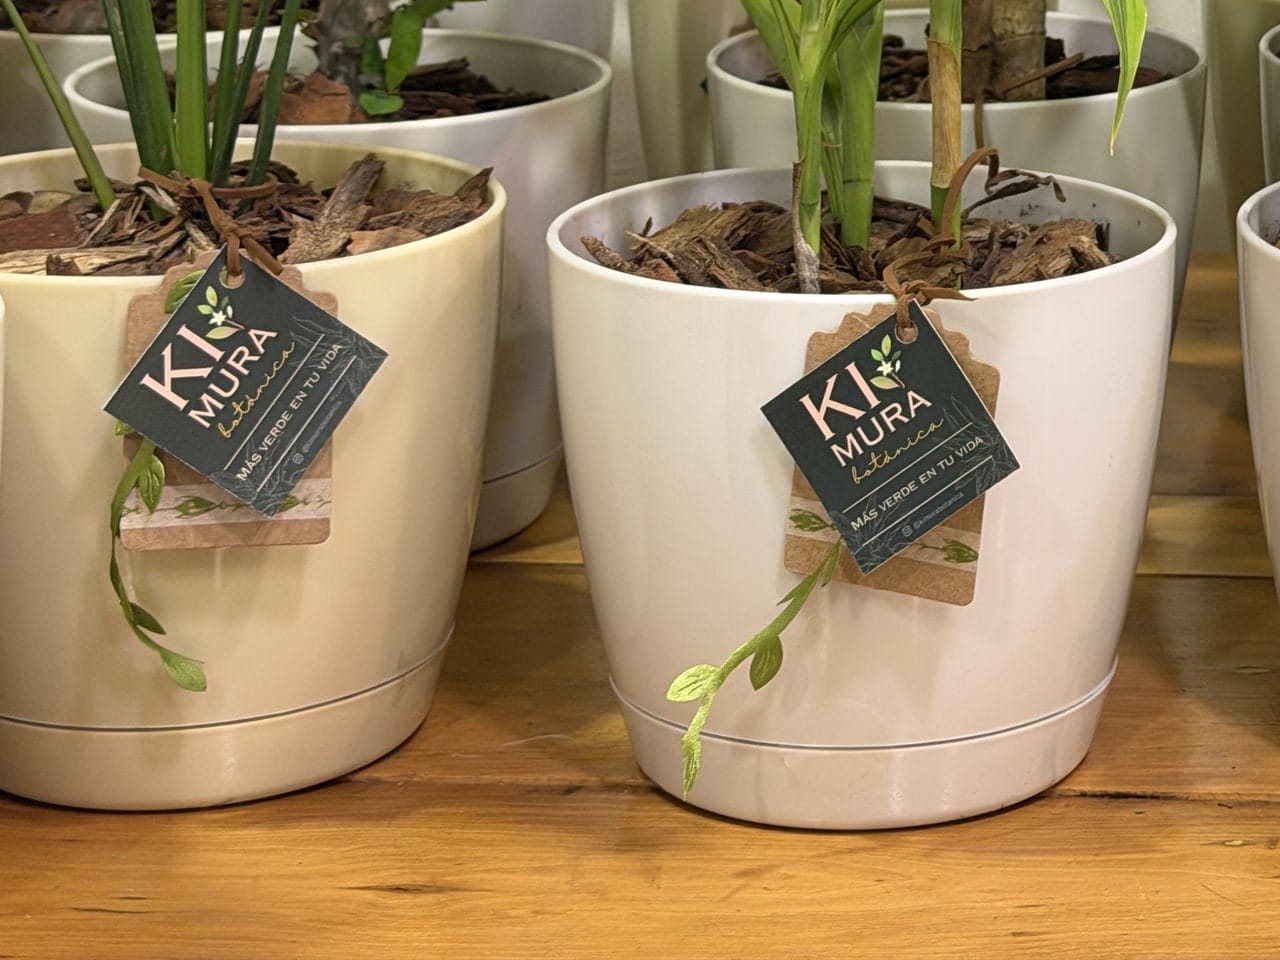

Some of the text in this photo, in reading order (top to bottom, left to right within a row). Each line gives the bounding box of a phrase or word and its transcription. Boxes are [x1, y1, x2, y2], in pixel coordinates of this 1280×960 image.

[140, 324, 225, 411] KI
[187, 328, 278, 428] MURA
[236, 452, 262, 481] MÁS
[260, 410, 293, 457] VERDE
[290, 390, 309, 413] EN
[304, 373, 320, 393] TU
[320, 343, 343, 374] VIDA
[800, 362, 882, 441] KI
[830, 390, 933, 468] MURA
[851, 435, 984, 531] MÁS VERDE EN TU VIDA
